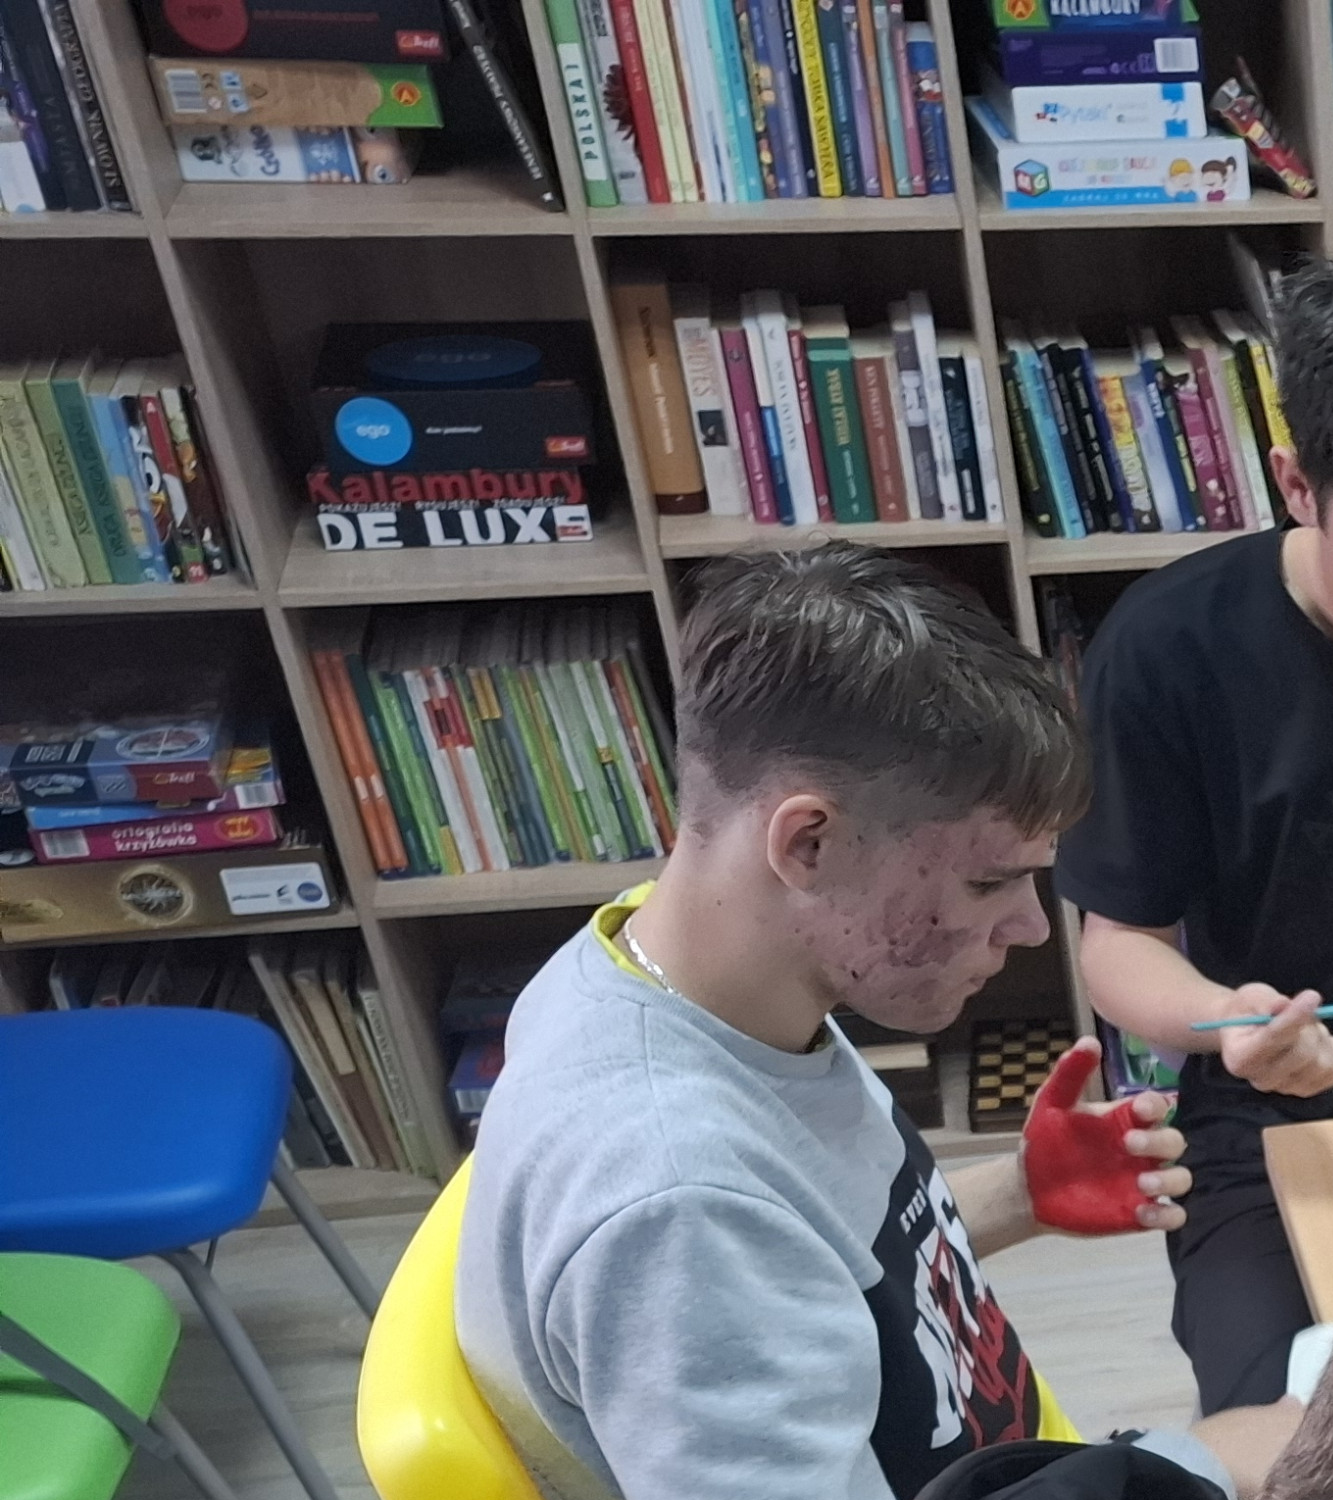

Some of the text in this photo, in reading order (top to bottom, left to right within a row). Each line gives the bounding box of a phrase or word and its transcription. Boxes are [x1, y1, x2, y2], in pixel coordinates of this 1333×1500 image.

[567, 78, 599, 161] POLSKA
[355, 423, 392, 440] ego
[306, 466, 585, 505] Kalambury
[316, 502, 594, 551] DE LUXE
